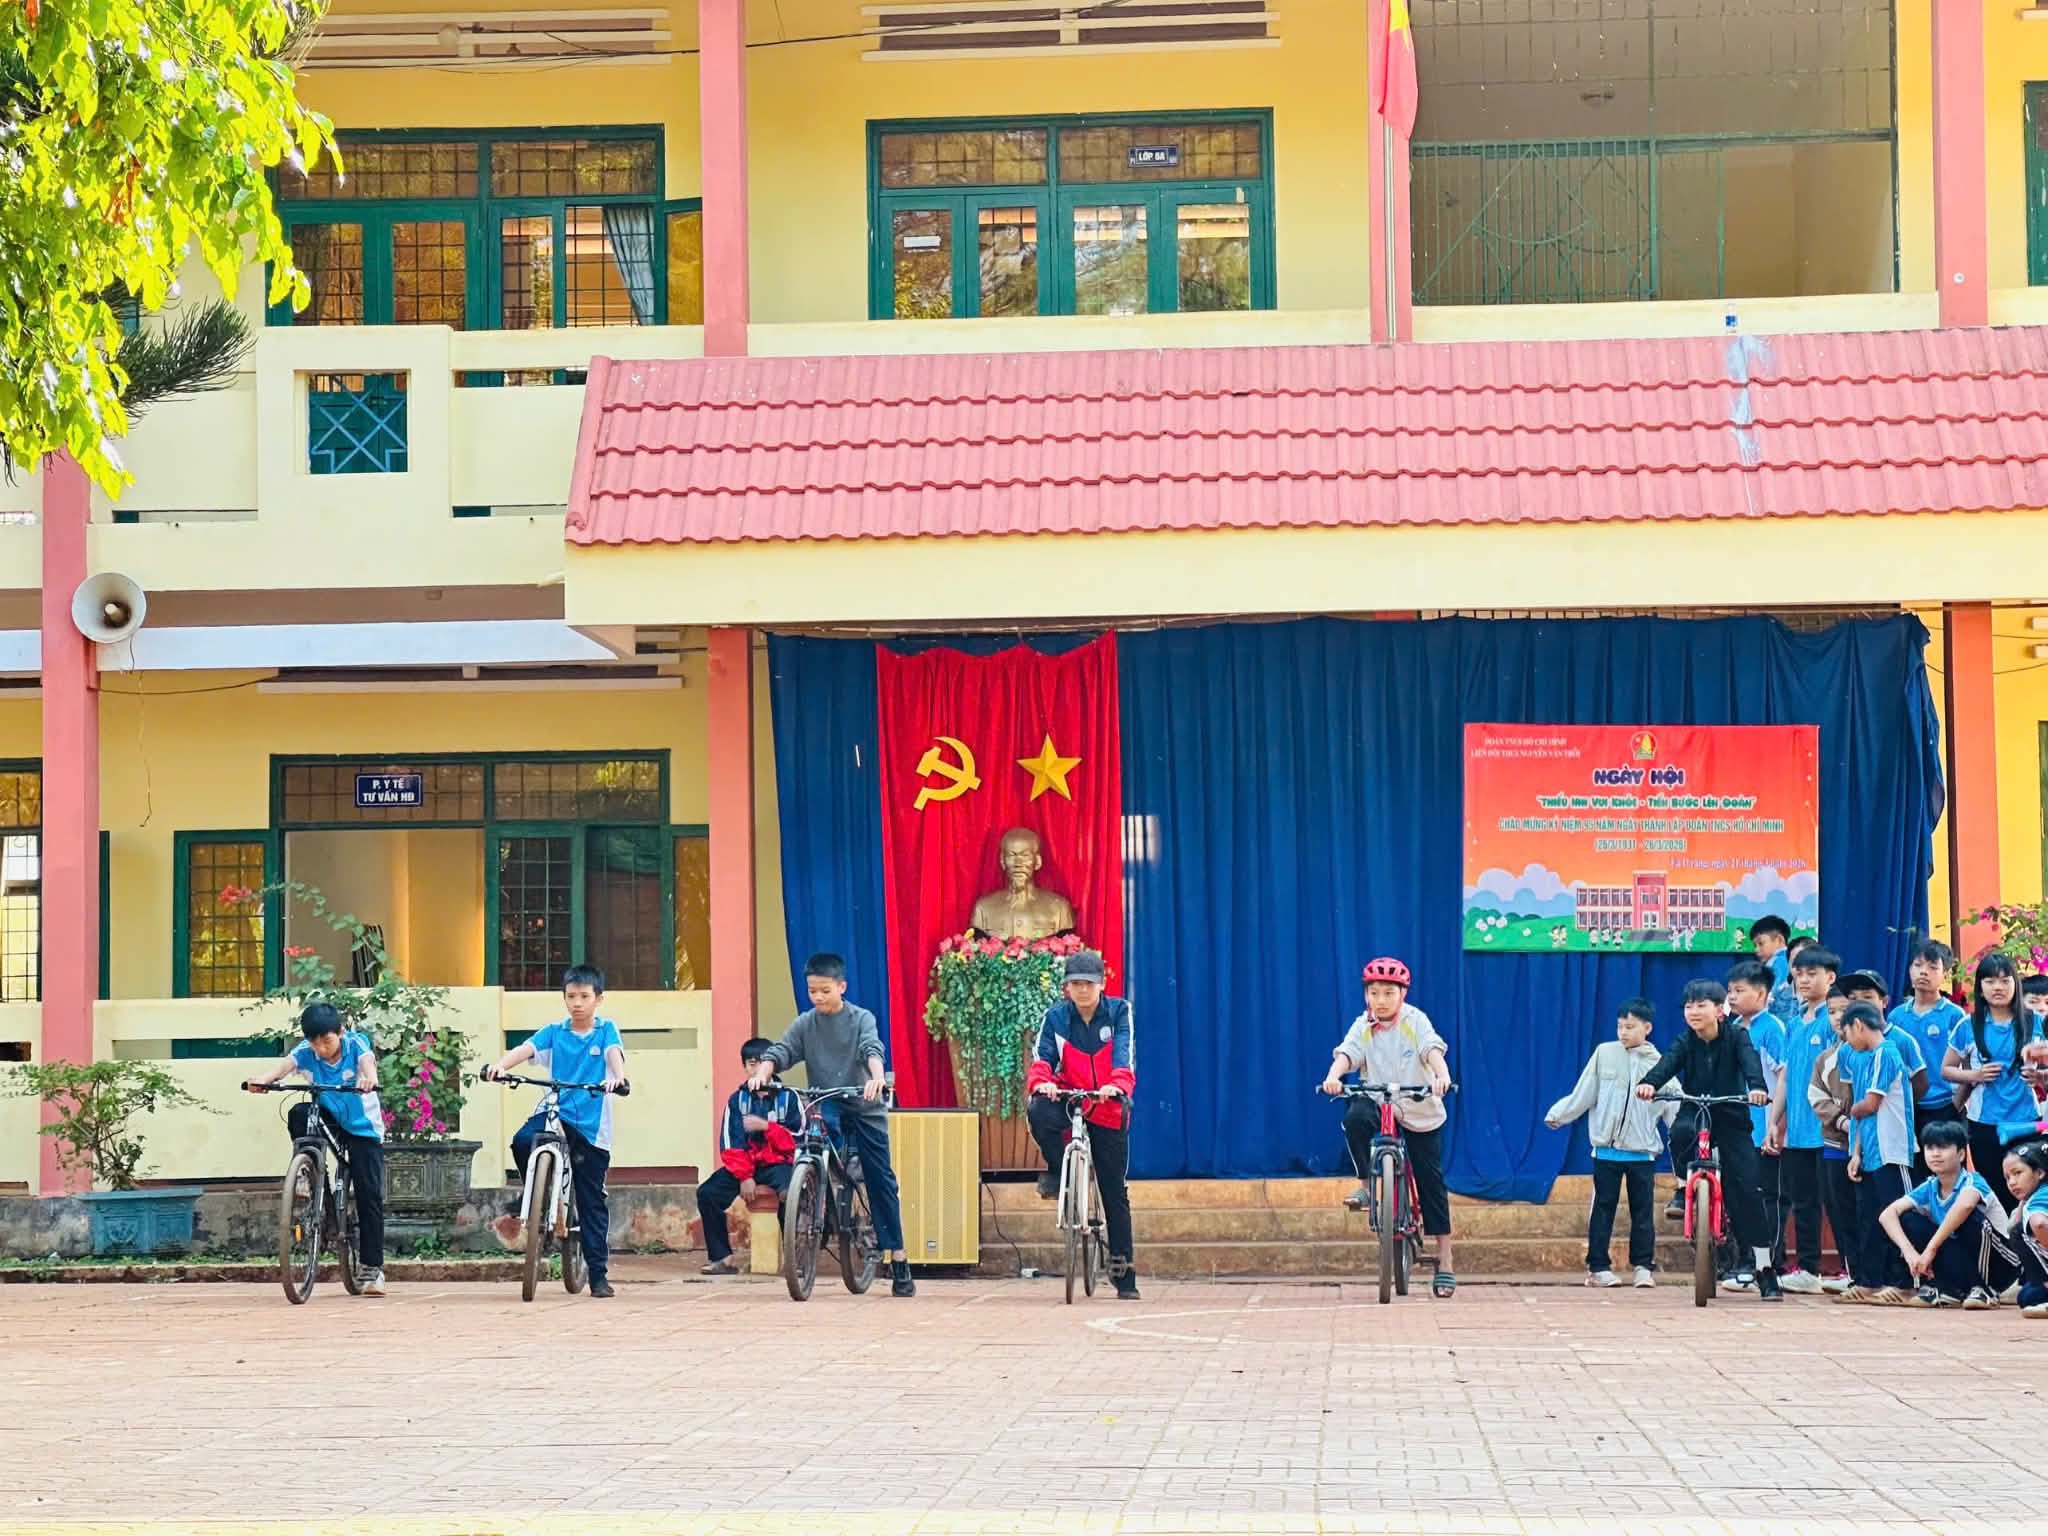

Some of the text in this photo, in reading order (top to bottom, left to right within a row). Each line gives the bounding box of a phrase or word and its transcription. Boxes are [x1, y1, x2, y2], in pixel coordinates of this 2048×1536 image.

[1138, 151, 1153, 161] LỚP
[1594, 765, 1684, 788] NGÀY HỘI
[373, 780, 381, 789] P.
[362, 792, 376, 802] TƯ
[377, 789, 399, 802] VẤN
[1591, 796, 1609, 808] VUI
[1702, 794, 1719, 808] LÊN
[1499, 816, 1520, 832] CHÀO
[1522, 816, 1547, 832] MỪNG
[1560, 816, 1582, 834] NIỆM
[1595, 816, 1614, 832] NĂM
[1616, 816, 1638, 832] NGÀY
[1641, 816, 1667, 832] THÀNH
[1669, 816, 1684, 833] LẬP
[1711, 818, 1731, 832] TNCS
[1732, 815, 1745, 832] HỒ
[1746, 815, 1760, 832] CHÍ
[1762, 817, 1784, 832] MINH
